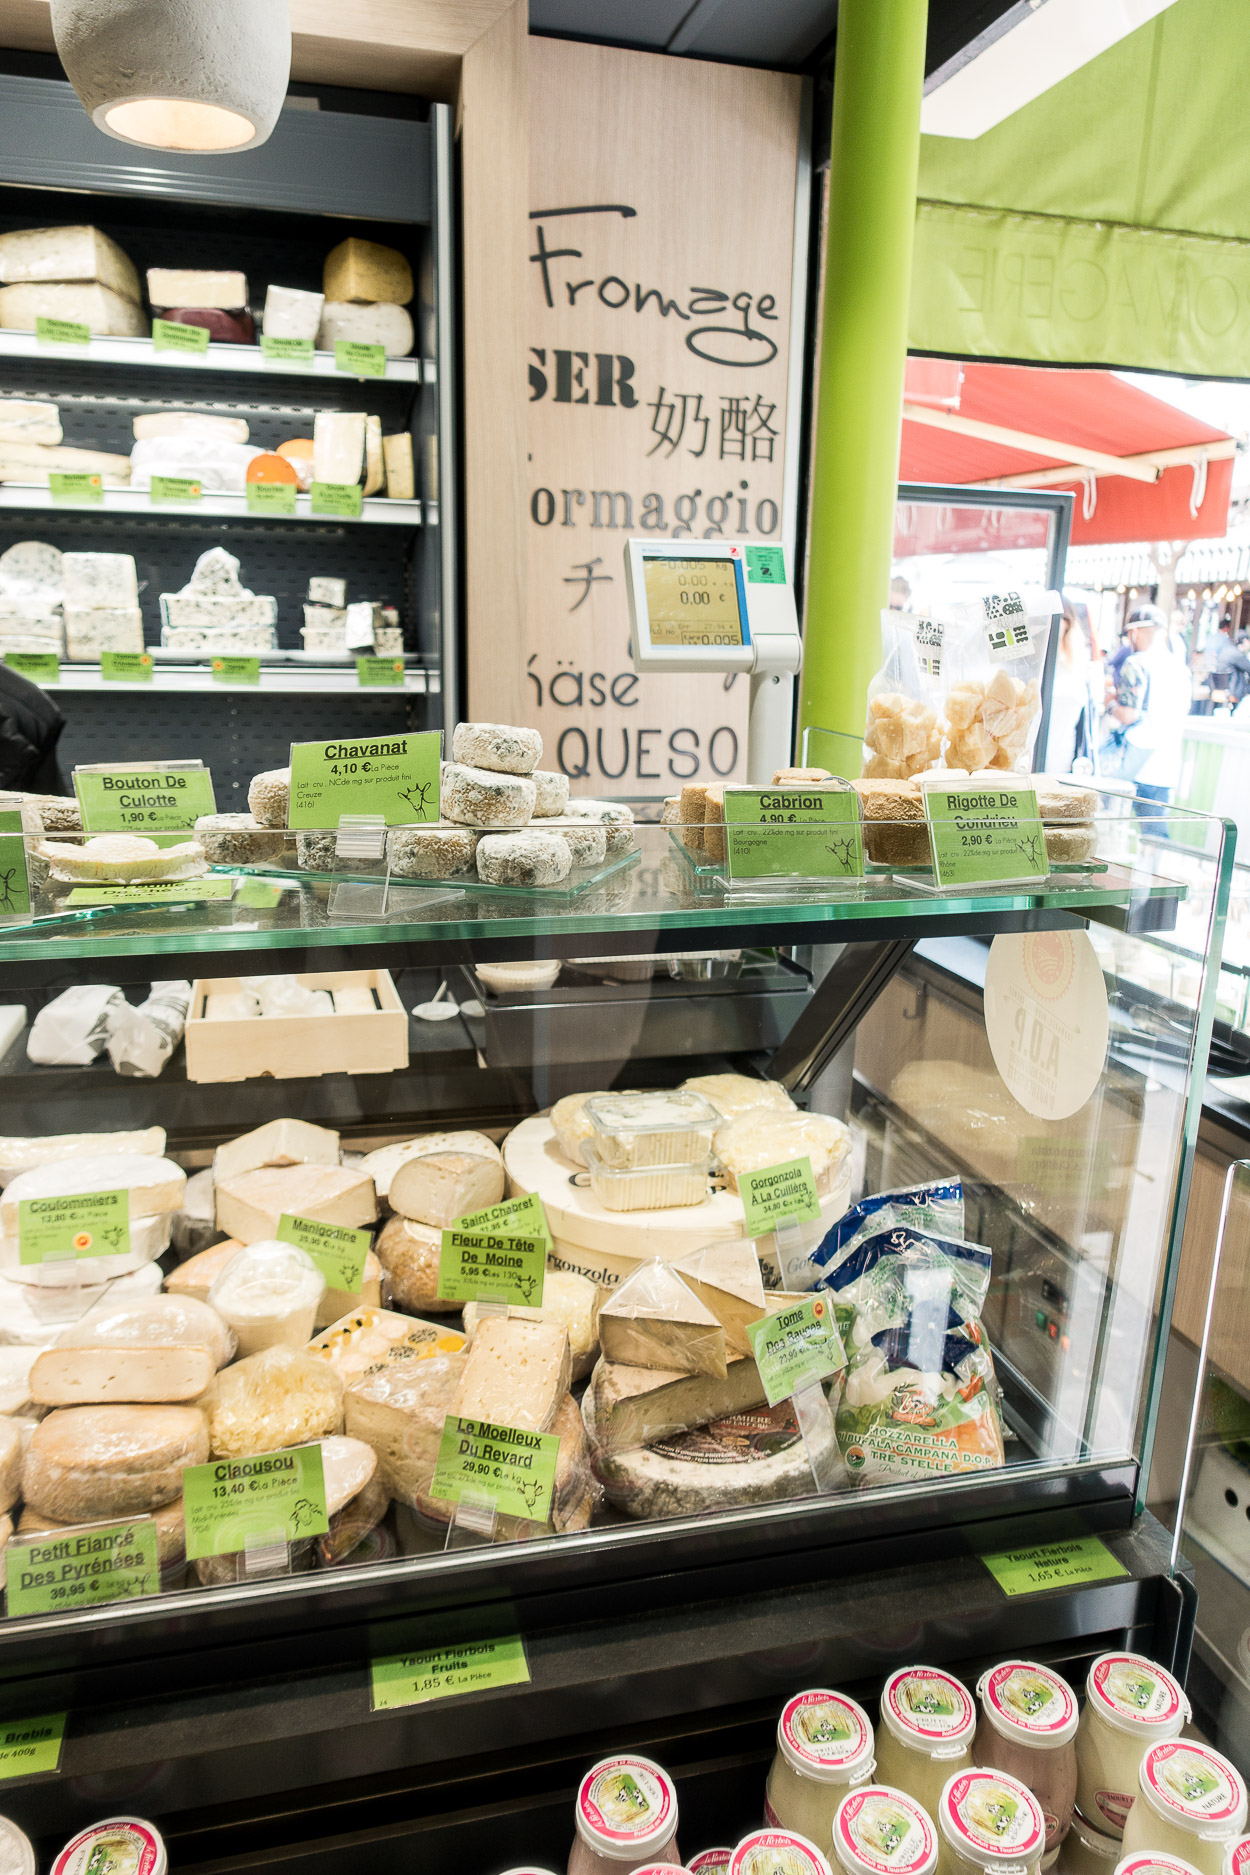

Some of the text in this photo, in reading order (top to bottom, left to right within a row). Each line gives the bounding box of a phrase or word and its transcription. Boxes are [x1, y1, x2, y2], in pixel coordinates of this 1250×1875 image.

[528, 204, 778, 368] Fromage
[646, 384, 780, 464] 奶酪
[324, 740, 408, 760] Chavanat
[558, 726, 740, 780] QUESO
[330, 762, 358, 776] 4,10
[361, 762, 372, 774] €
[380, 762, 400, 772] Pièce
[374, 774, 400, 784] produit
[102, 774, 188, 790] Bouton De
[120, 794, 178, 810] Culotte
[296, 790, 322, 800] Creuze
[760, 794, 824, 809] Cabrion
[946, 792, 1018, 812] Rigotte De
[120, 812, 144, 824] 1,90
[148, 811, 158, 822] €
[806, 828, 828, 837] produit
[960, 834, 984, 848] 2,90
[984, 834, 994, 846] €
[1002, 836, 1018, 844] Pièce
[732, 838, 768, 848] Bourgogne
[750, 1168, 802, 1192] Gorgonzola
[28, 1194, 118, 1214] Coulommiers
[760, 1192, 772, 1204] La
[460, 1198, 534, 1230] Saint Chabret
[292, 1218, 358, 1244] Manigodine
[452, 1234, 536, 1252] Fleur De Tête
[461, 1250, 524, 1268] De Moine
[776, 1309, 805, 1332] Tome
[457, 1417, 542, 1448] Le Moelleux
[869, 1425, 958, 1450] MOZZARELLA
[458, 1439, 534, 1468] Du Revard
[846, 1434, 894, 1451] BUFALA
[895, 1443, 959, 1462] CAMPANA
[962, 1454, 996, 1467] D.O.P.
[214, 1455, 295, 1482] Claousou
[462, 1460, 490, 1476] 29,90
[870, 1450, 954, 1473] TRE STELLE
[212, 1482, 246, 1499] 13,40
[270, 1476, 298, 1488] Pièce
[29, 1528, 136, 1564] Petit Fiancé
[1004, 1543, 1084, 1564] Yaourt Fierbois
[20, 1551, 145, 1590] Des Pyrénées
[1033, 1556, 1070, 1570] Nature
[1028, 1570, 1054, 1584] 1,65
[1064, 1568, 1075, 1576] La
[401, 1642, 496, 1668] Yaourt Fierbois
[431, 1660, 469, 1675] Fruits
[412, 1677, 442, 1692] 1,85
[457, 1674, 468, 1684] La
[470, 1670, 492, 1682] Pièce
[1154, 1690, 1168, 1713] NATURE
[4, 1727, 54, 1744] Brebis
[10, 1746, 37, 1758] 400g
[1201, 1792, 1228, 1811] NATURE
